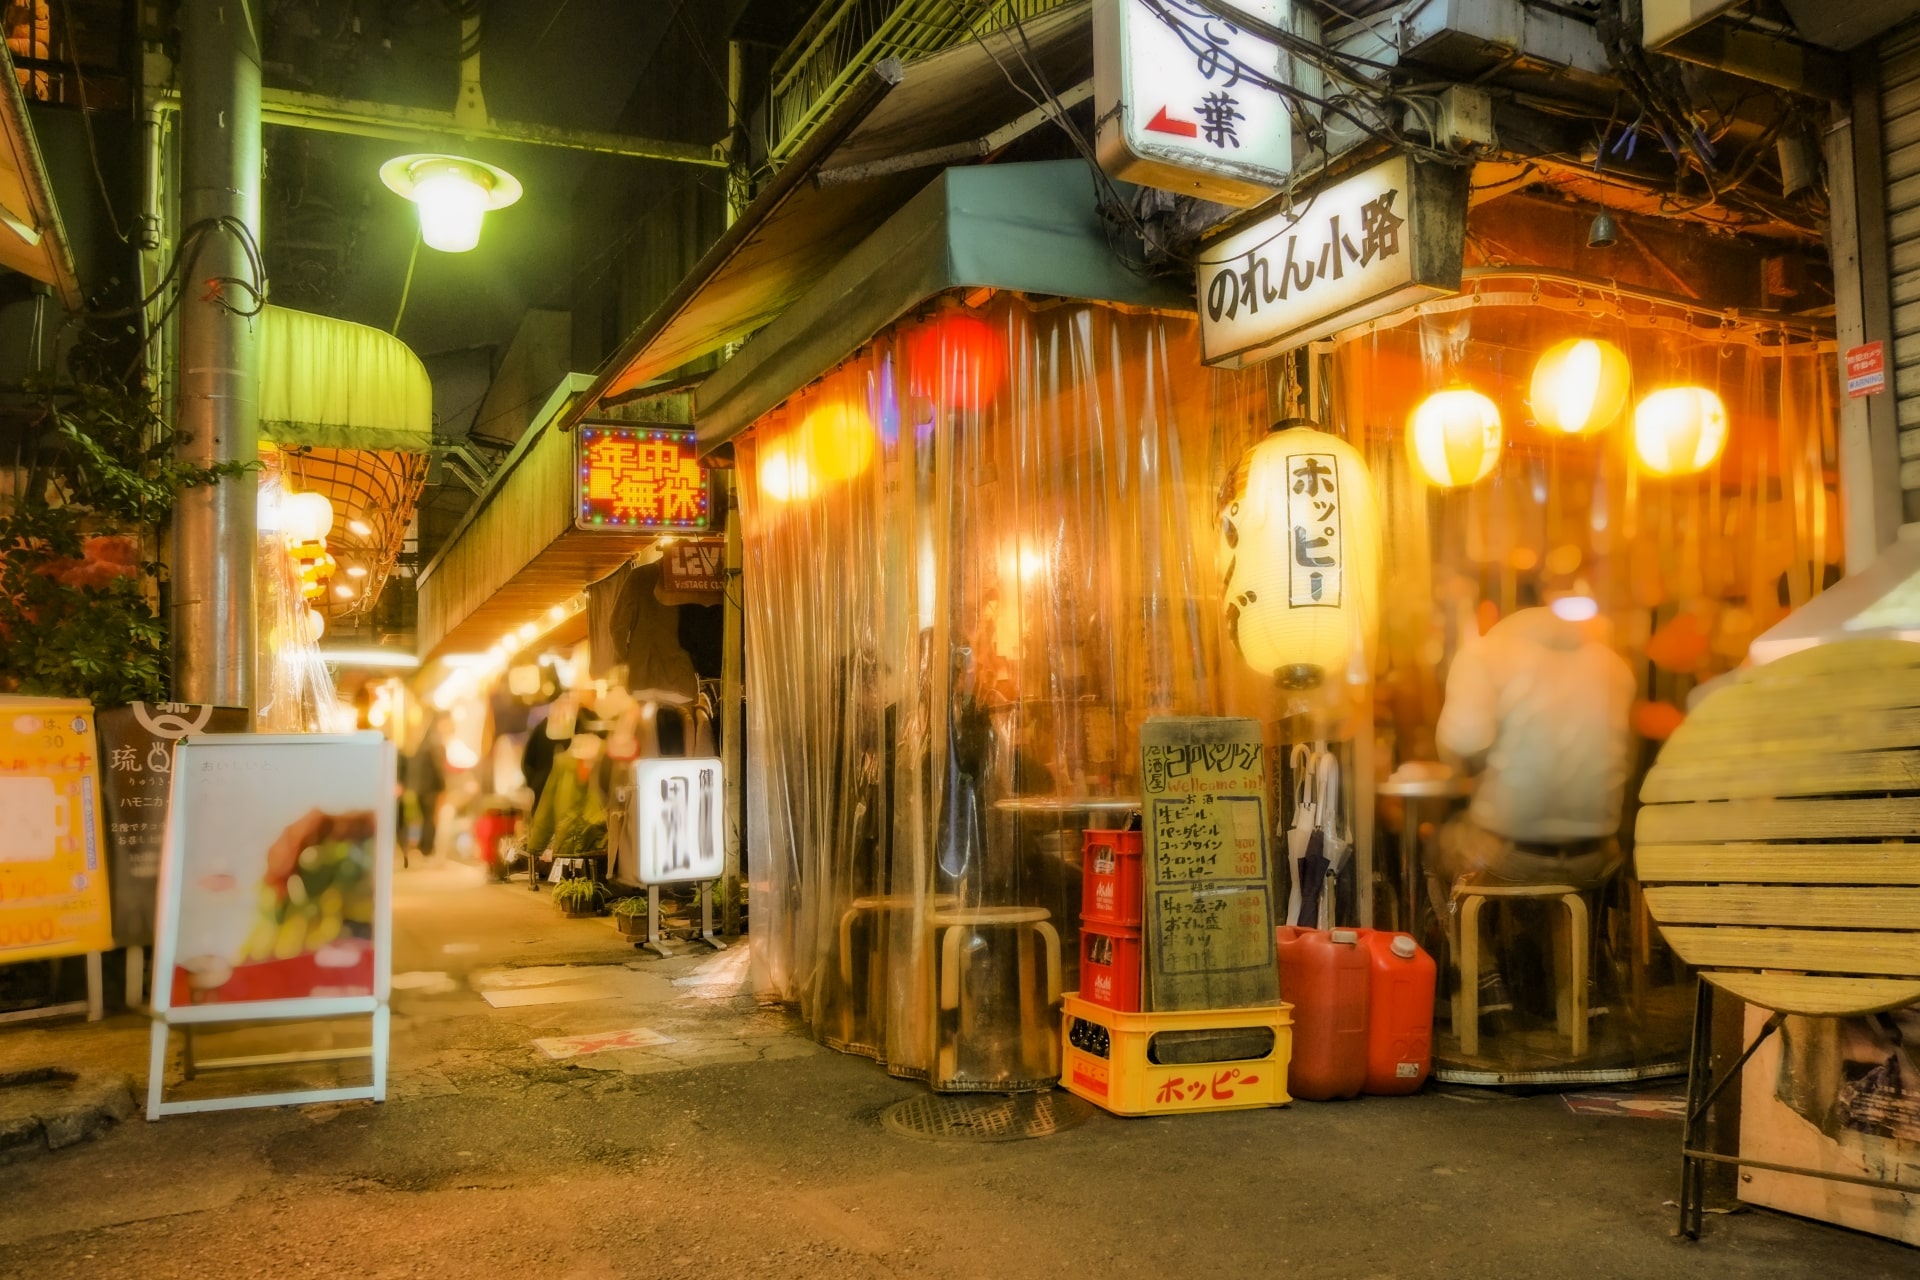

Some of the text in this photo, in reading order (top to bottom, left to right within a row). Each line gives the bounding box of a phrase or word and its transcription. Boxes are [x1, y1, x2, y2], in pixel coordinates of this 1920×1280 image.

[1207, 187, 1405, 323] のれん小路
[1848, 372, 1883, 390] WARNING
[589, 437, 679, 480] 年中
[612, 476, 700, 519] 無休
[1292, 457, 1337, 602] ホッピー
[1155, 1067, 1260, 1103] ホッピー
